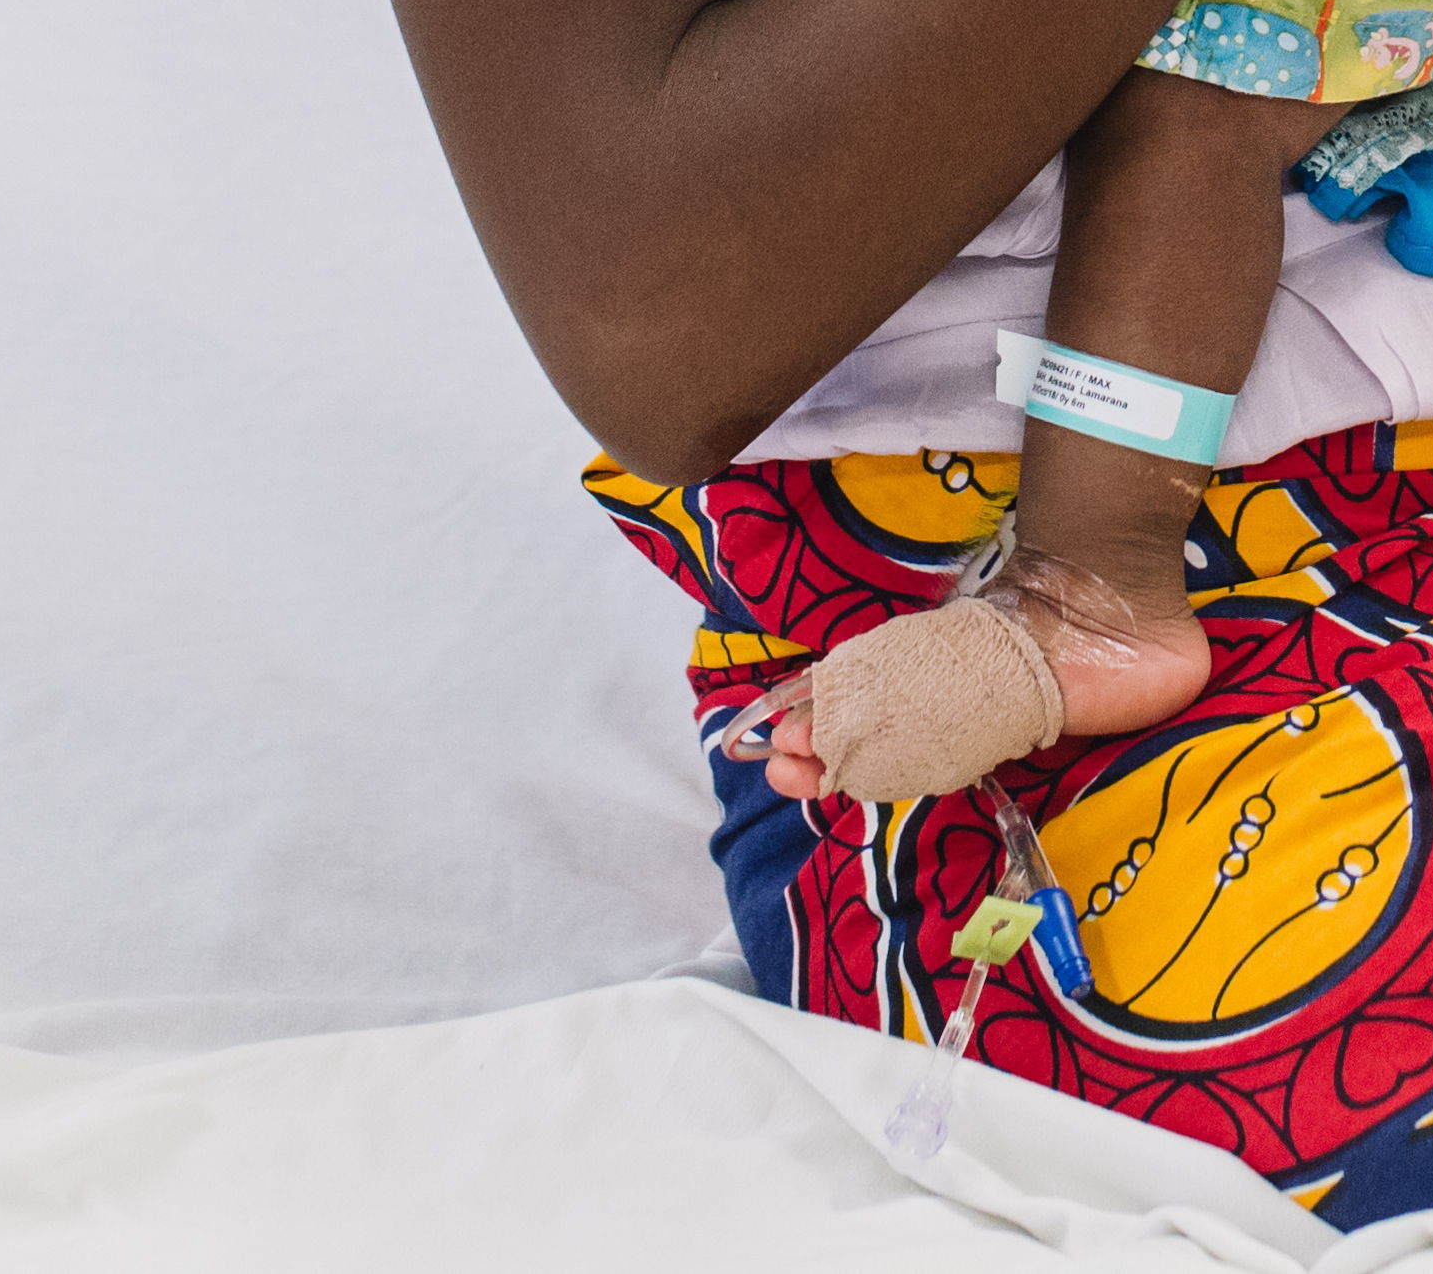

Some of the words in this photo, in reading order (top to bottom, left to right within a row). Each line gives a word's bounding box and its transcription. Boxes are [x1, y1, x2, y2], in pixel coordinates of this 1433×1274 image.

[1075, 371, 1082, 379] F
[1088, 375, 1112, 389] MAX
[1048, 375, 1075, 391] Aissata
[1079, 386, 1128, 409] Lamarana
[1060, 393, 1070, 406] 0y
[1071, 398, 1086, 410] 6m
